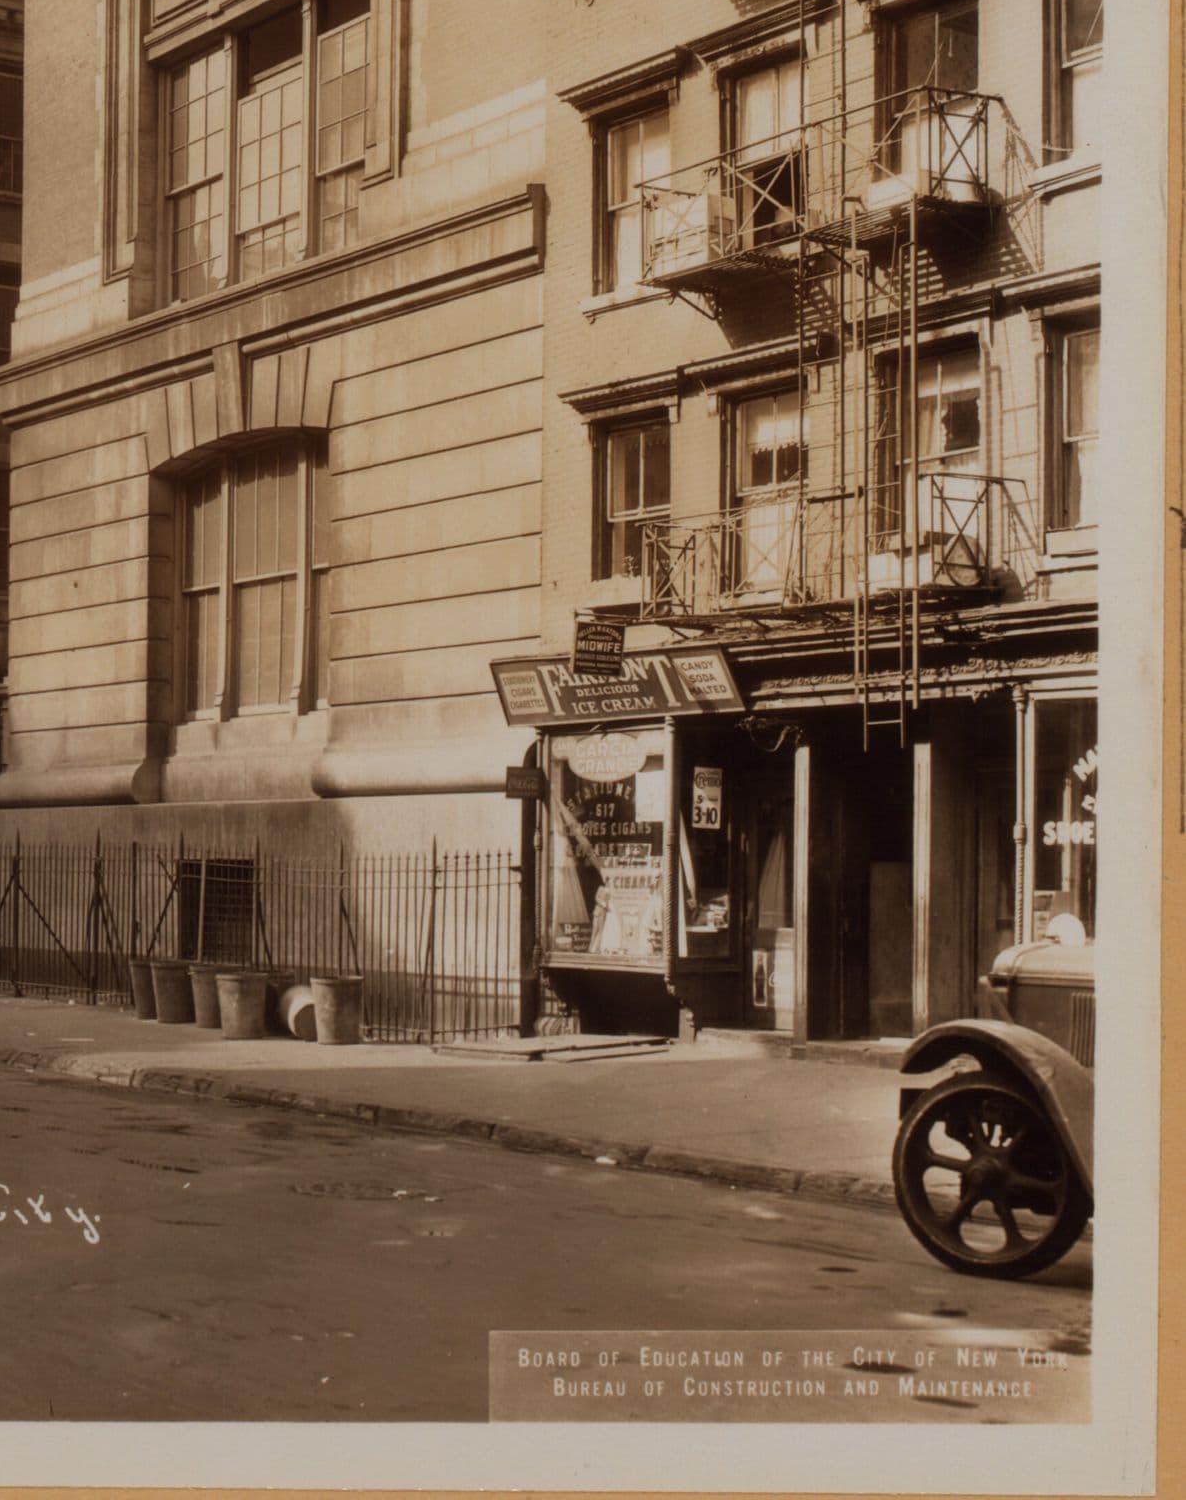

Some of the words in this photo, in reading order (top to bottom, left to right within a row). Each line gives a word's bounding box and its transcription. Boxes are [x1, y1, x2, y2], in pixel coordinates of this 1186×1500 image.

[577, 640, 621, 654] MIDWIFE
[680, 660, 714, 672] CANDY
[688, 673, 718, 683] SODA
[576, 684, 640, 697] DELICIOUS
[688, 684, 727, 696] MALTED
[571, 701, 599, 715] ICE
[601, 696, 655, 713] CREAM
[566, 781, 636, 813] STATIONE
[611, 821, 652, 836] CIGARS
